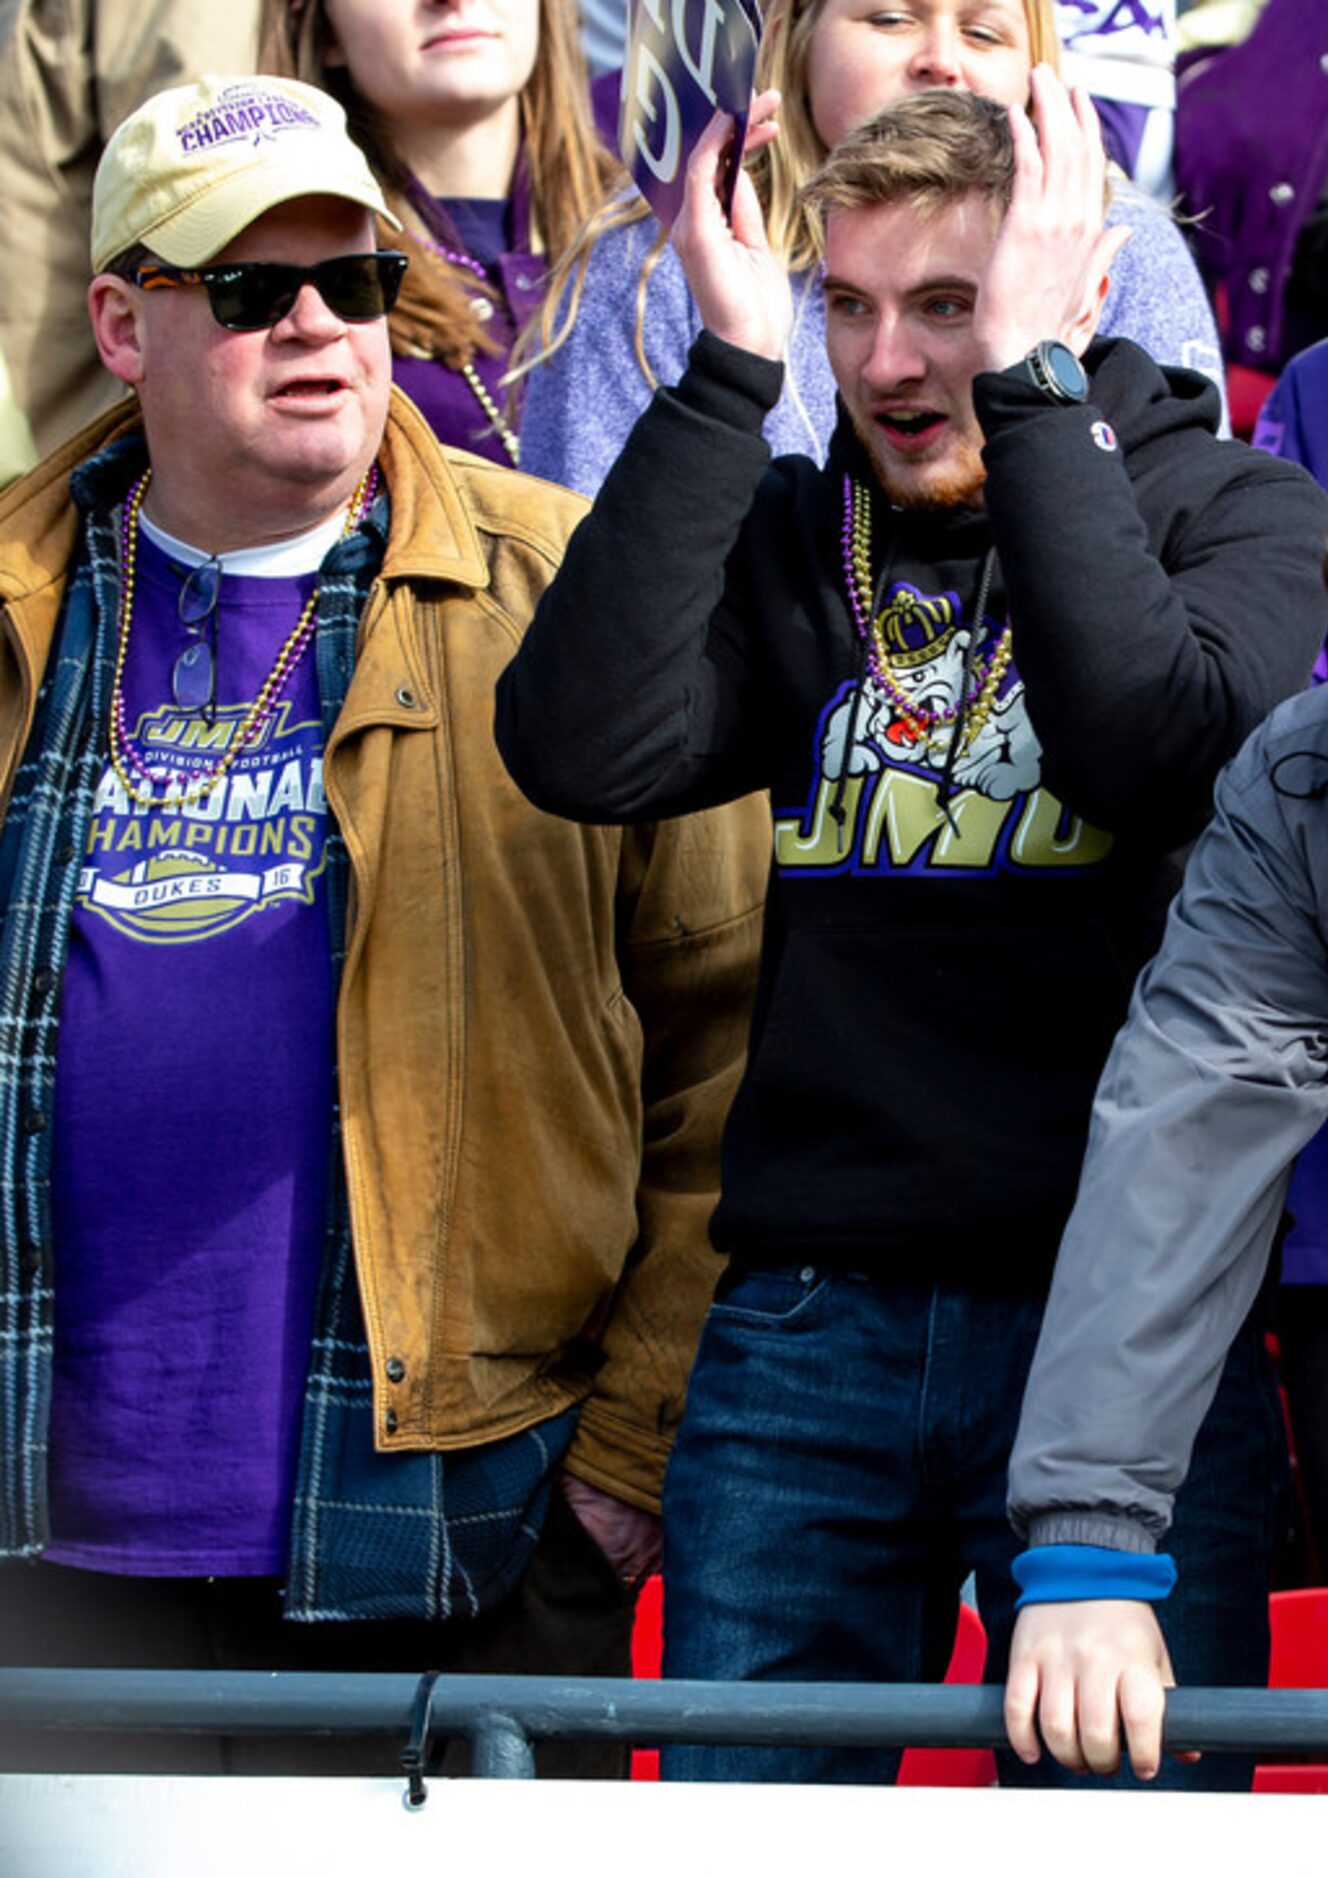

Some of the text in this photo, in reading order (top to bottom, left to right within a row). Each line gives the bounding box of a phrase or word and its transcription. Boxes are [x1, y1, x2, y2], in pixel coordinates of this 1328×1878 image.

[145, 716, 268, 751] JMU
[93, 757, 329, 822] ATIONAL
[86, 815, 317, 860] HAMPIONS
[774, 767, 1115, 867] JMU
[134, 877, 222, 906] DUKES
[273, 868, 291, 887] 16
